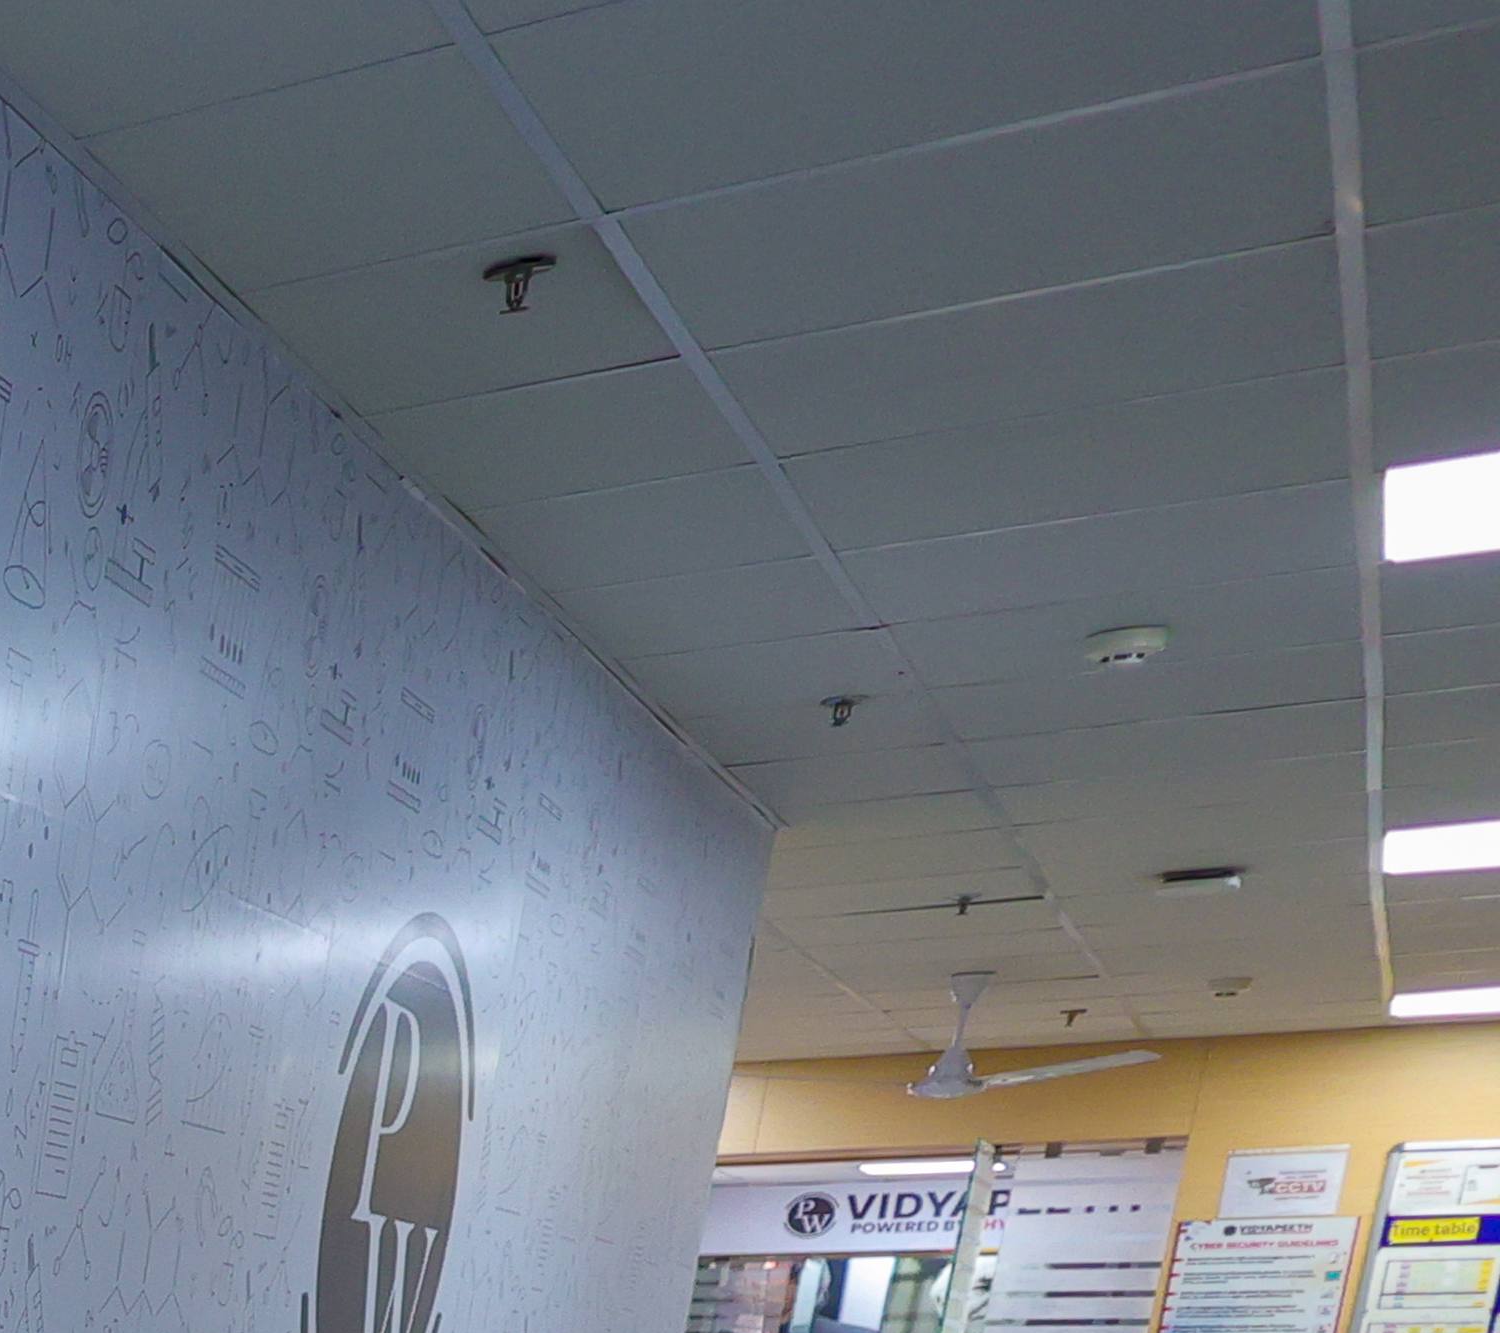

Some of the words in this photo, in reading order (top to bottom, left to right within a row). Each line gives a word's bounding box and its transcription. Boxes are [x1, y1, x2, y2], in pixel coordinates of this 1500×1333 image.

[1275, 1181, 1324, 1193] CCTV
[851, 1221, 938, 1233] POWERED
[1435, 1223, 1475, 1235] table
